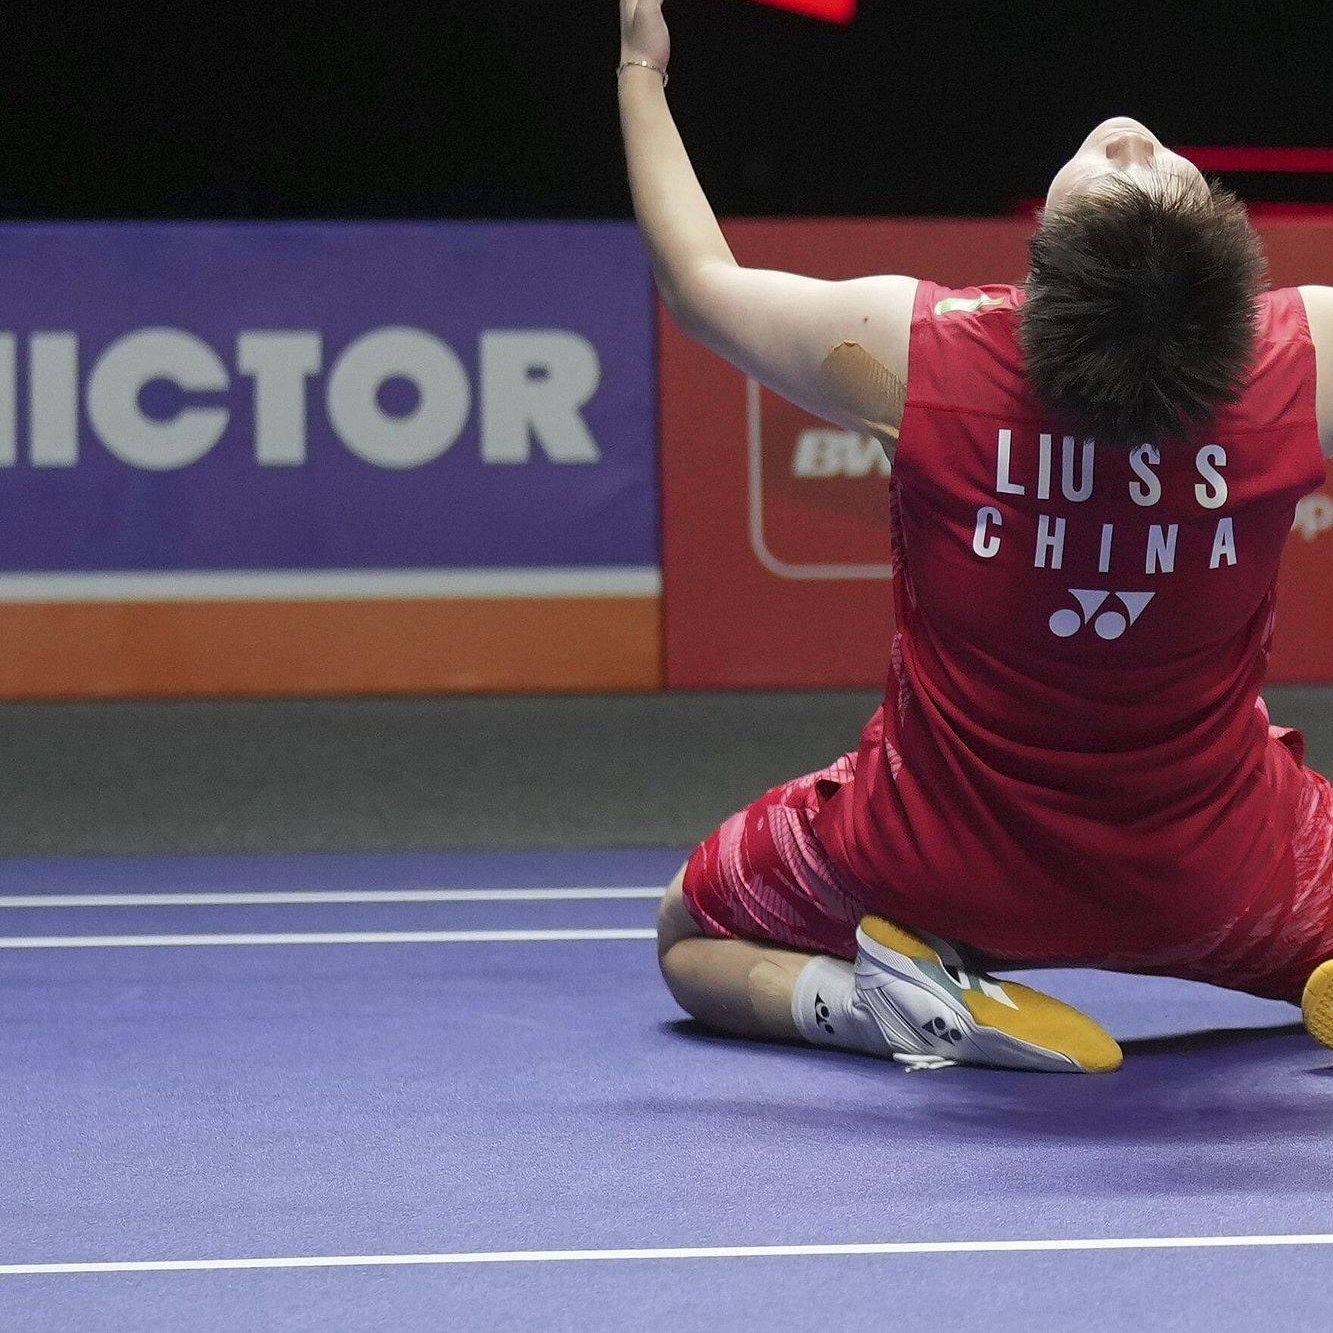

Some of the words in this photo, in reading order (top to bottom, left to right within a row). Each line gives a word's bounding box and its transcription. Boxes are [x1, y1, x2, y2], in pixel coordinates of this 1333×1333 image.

[0, 326, 601, 470] ICTOR
[793, 428, 892, 478] BW
[996, 429, 1095, 502] LIU
[1129, 443, 1162, 506] S
[1195, 444, 1228, 509] S
[973, 506, 1237, 574] CHINA
